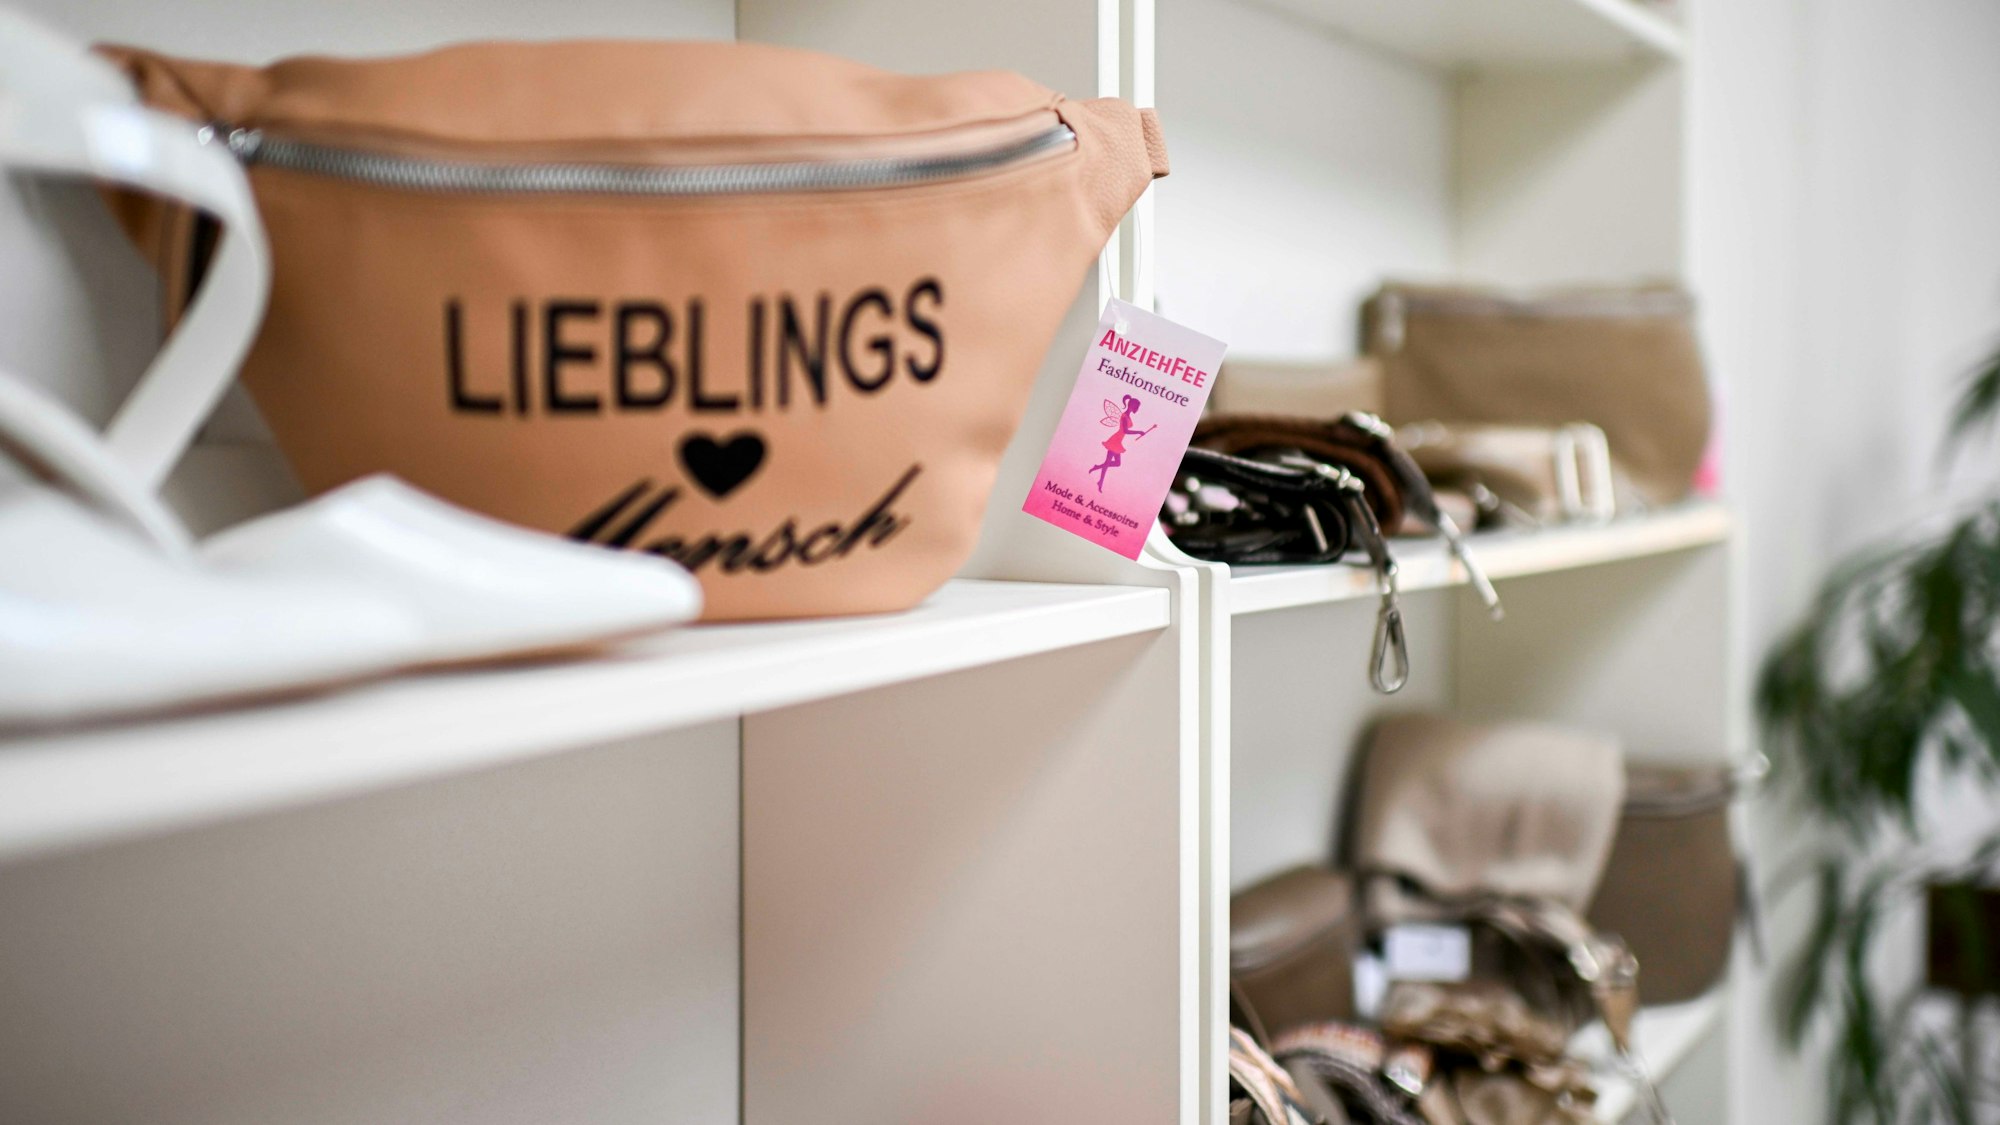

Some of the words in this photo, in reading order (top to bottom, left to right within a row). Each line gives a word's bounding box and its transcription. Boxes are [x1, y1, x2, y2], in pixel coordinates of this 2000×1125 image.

[445, 275, 945, 416] LIEBLINGS
[1097, 358, 1190, 407] Fashionstore
[1044, 480, 1074, 500] Mode
[1074, 494, 1084, 506] &
[1086, 500, 1139, 529] Accessoires
[1051, 500, 1081, 520] Home
[1083, 515, 1093, 526] &
[1094, 520, 1120, 537] Style
